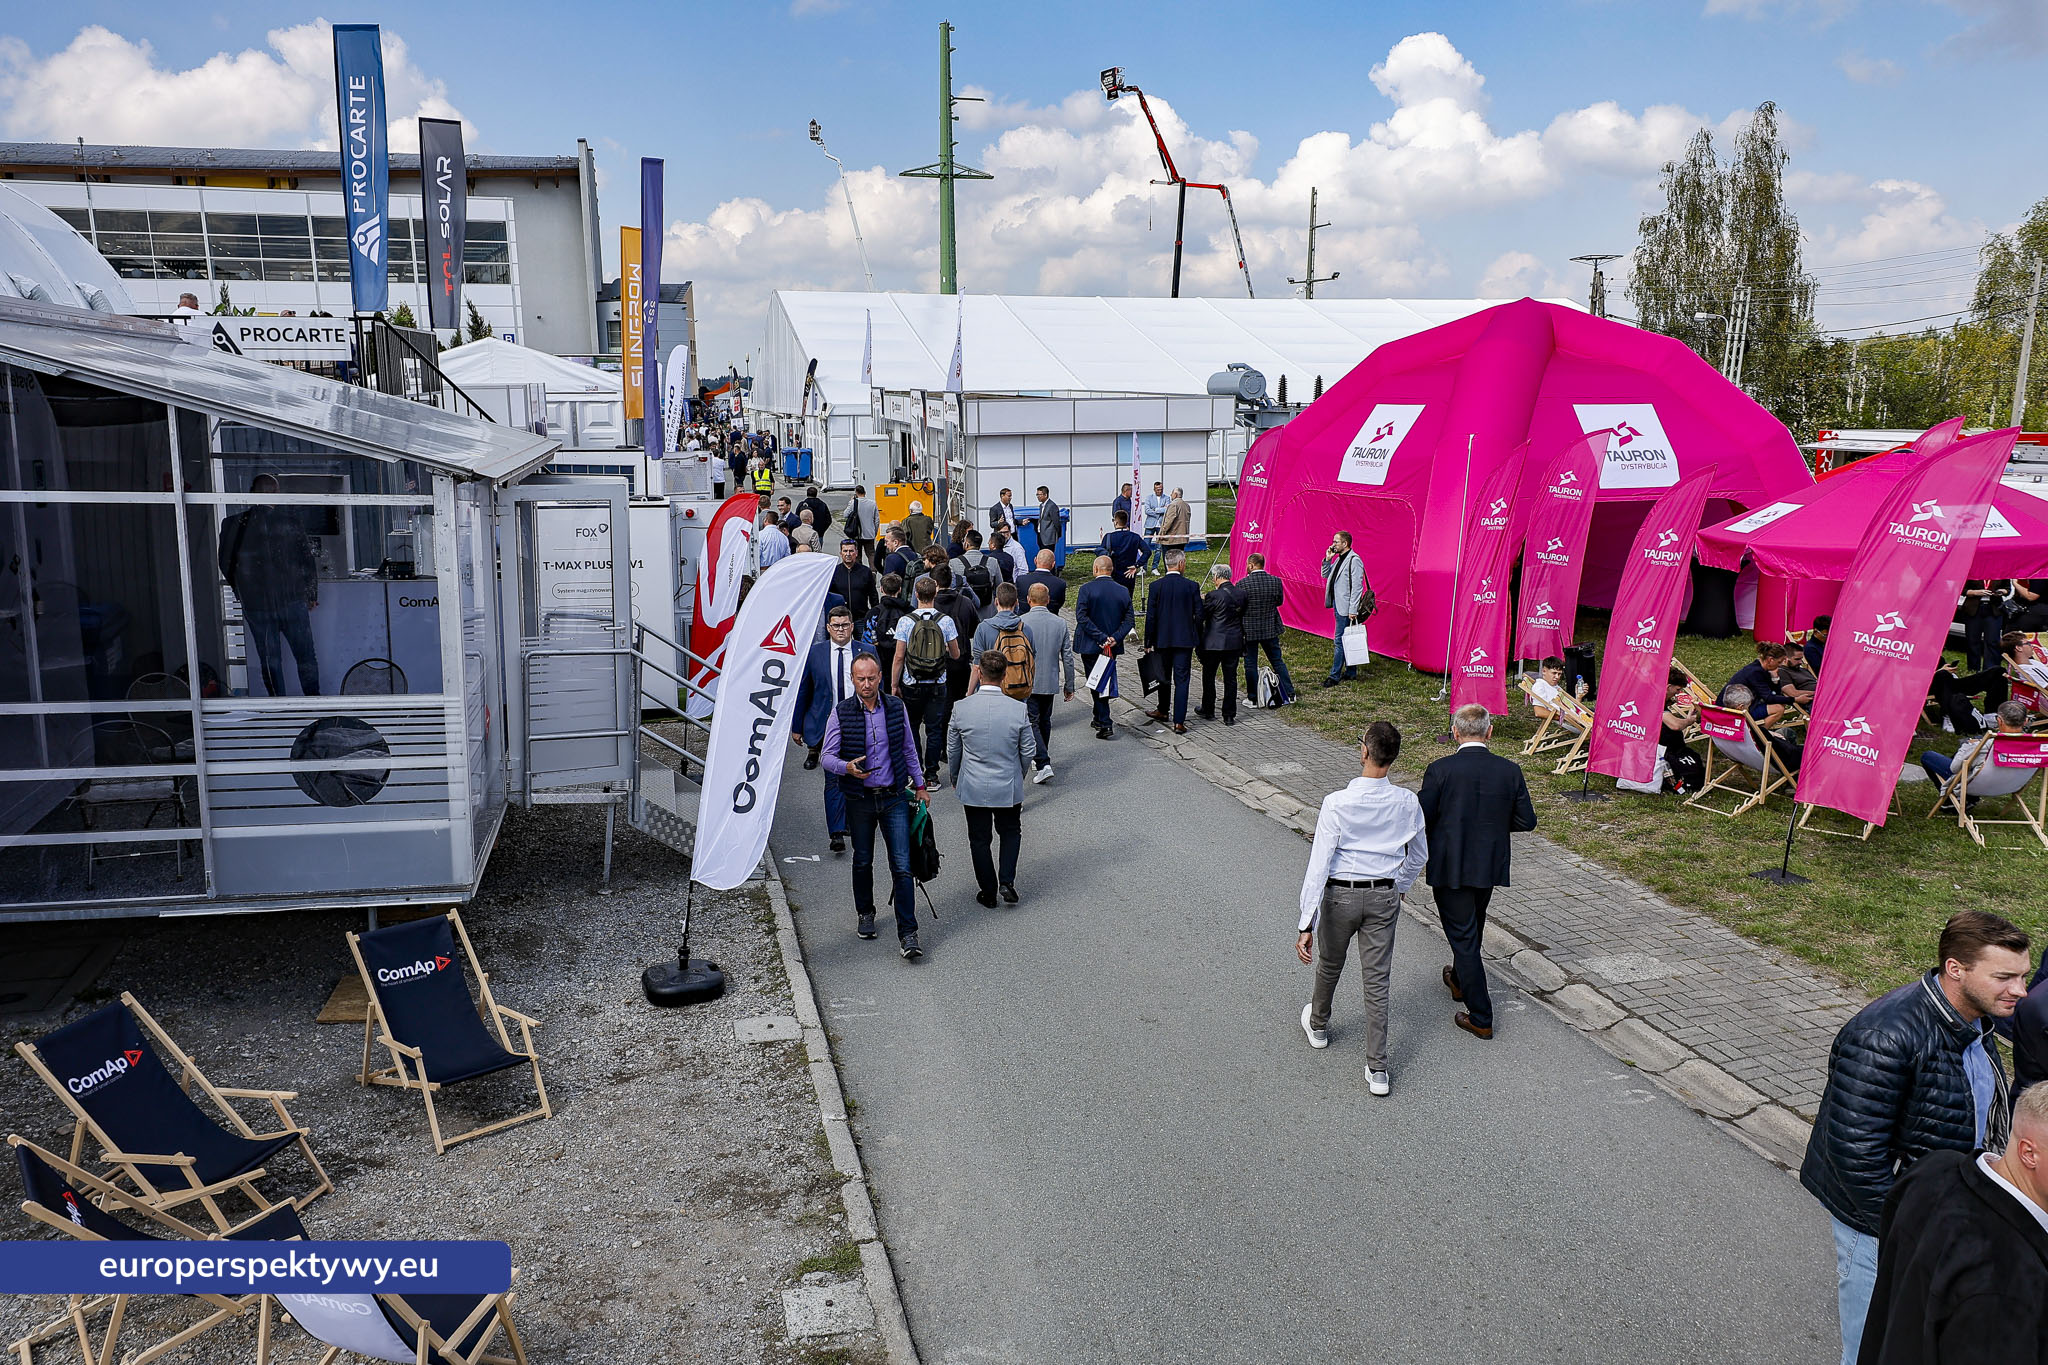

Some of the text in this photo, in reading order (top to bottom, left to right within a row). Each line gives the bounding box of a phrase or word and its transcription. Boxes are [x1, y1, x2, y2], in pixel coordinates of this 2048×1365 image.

[349, 75, 367, 213] PROCARTE
[436, 156, 452, 239] SOLAR
[239, 327, 346, 343] PROCARTE
[1352, 446, 1390, 459] TAURON
[1603, 449, 1667, 462] TAURON
[1548, 485, 1583, 497] TAURON
[575, 528, 598, 538] FOX
[1888, 521, 1952, 546] TAURON
[1897, 536, 1946, 552] DYSTRYBUCJA
[1536, 551, 1570, 562] TAURON
[543, 561, 581, 571] T-MAX
[584, 560, 613, 570] PLUS
[399, 596, 439, 608] ComA
[1526, 616, 1561, 627] TAURON
[1853, 630, 1915, 655] TAURON
[1863, 645, 1910, 661] DYSTRYBUCJA
[1461, 665, 1494, 674] TAURON
[1607, 719, 1647, 736] TAURON
[732, 658, 790, 815] ComAp
[1822, 735, 1880, 761] TAURON
[1831, 749, 1875, 768] DYSTRYBUCJA
[377, 960, 436, 982] ComAp
[68, 1057, 128, 1094] ComAp
